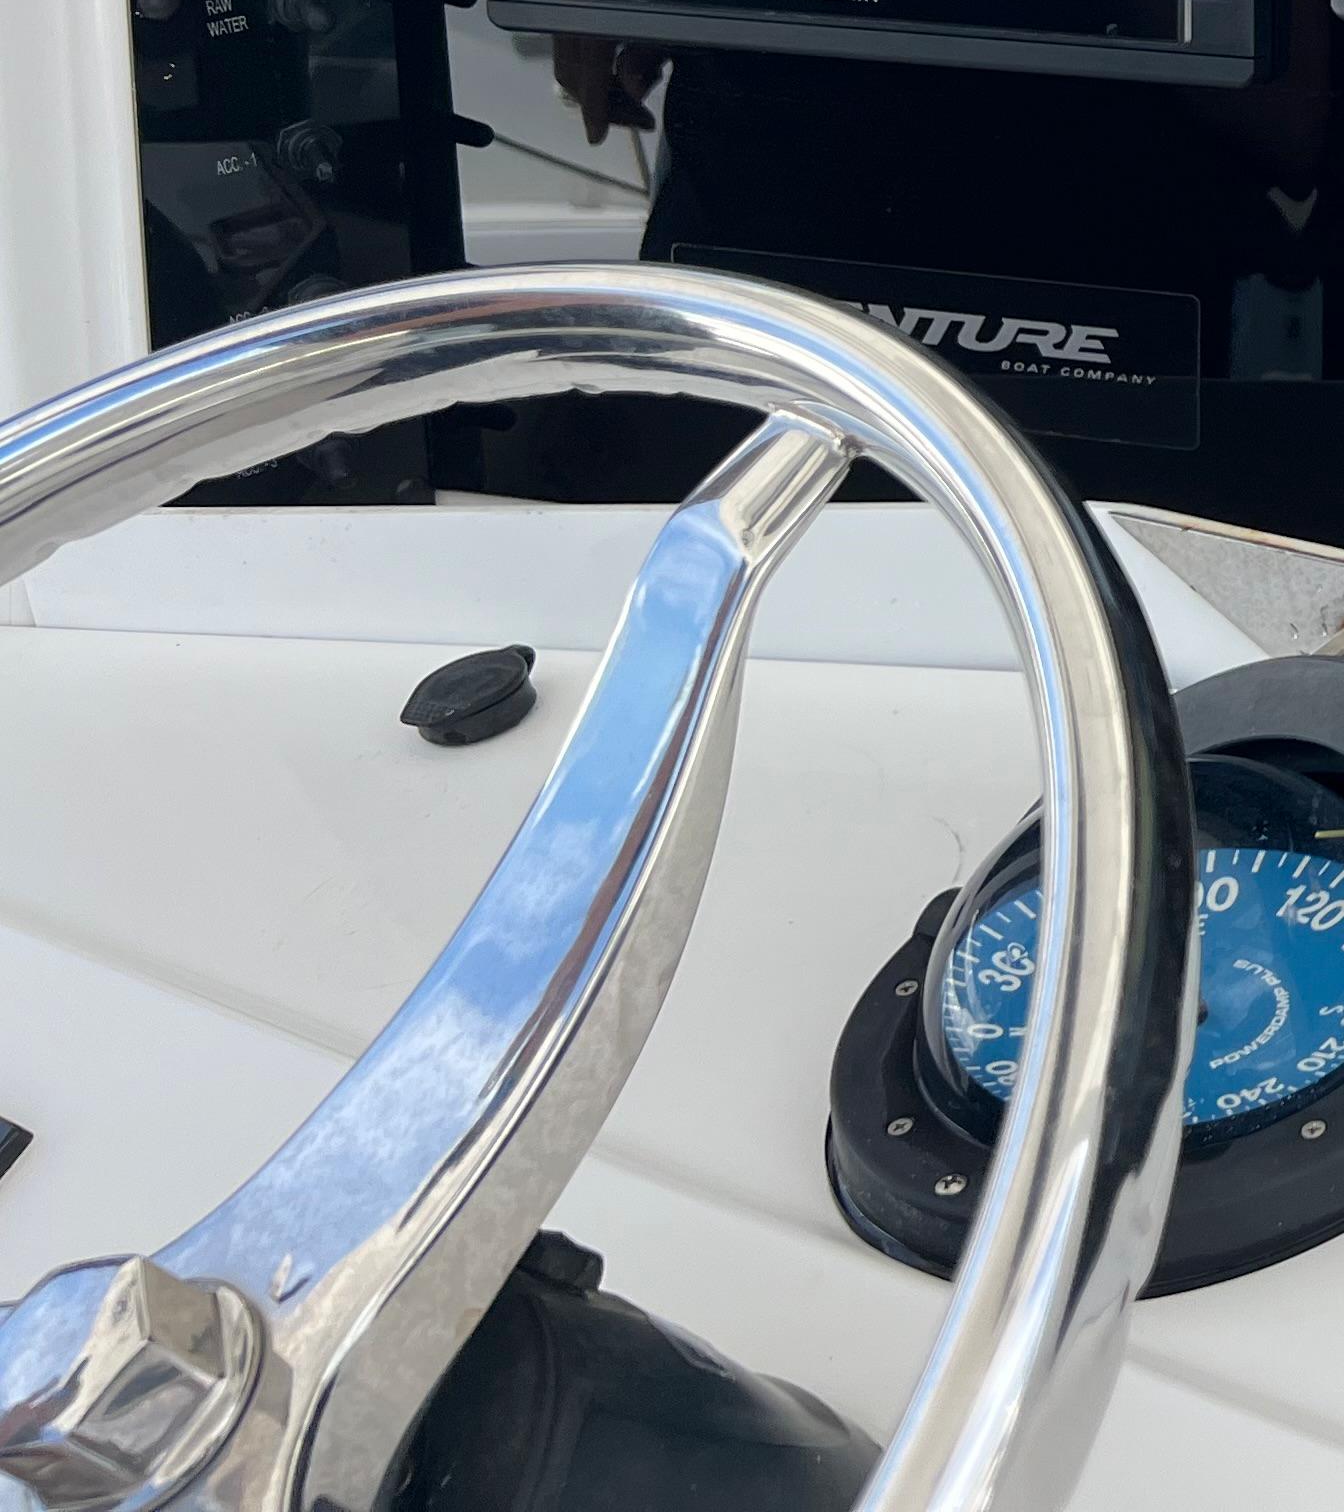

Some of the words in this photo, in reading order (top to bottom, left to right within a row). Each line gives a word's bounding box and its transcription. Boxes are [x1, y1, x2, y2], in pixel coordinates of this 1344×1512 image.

[206, 15, 248, 37] WATER
[1001, 360, 1052, 375] BOAT
[1060, 368, 1157, 386] COMPANY
[1233, 959, 1282, 987] PLUS
[1319, 1004, 1344, 1016] S
[1209, 987, 1290, 1069] POWERDAMP
[1217, 1076, 1284, 1110] 240
